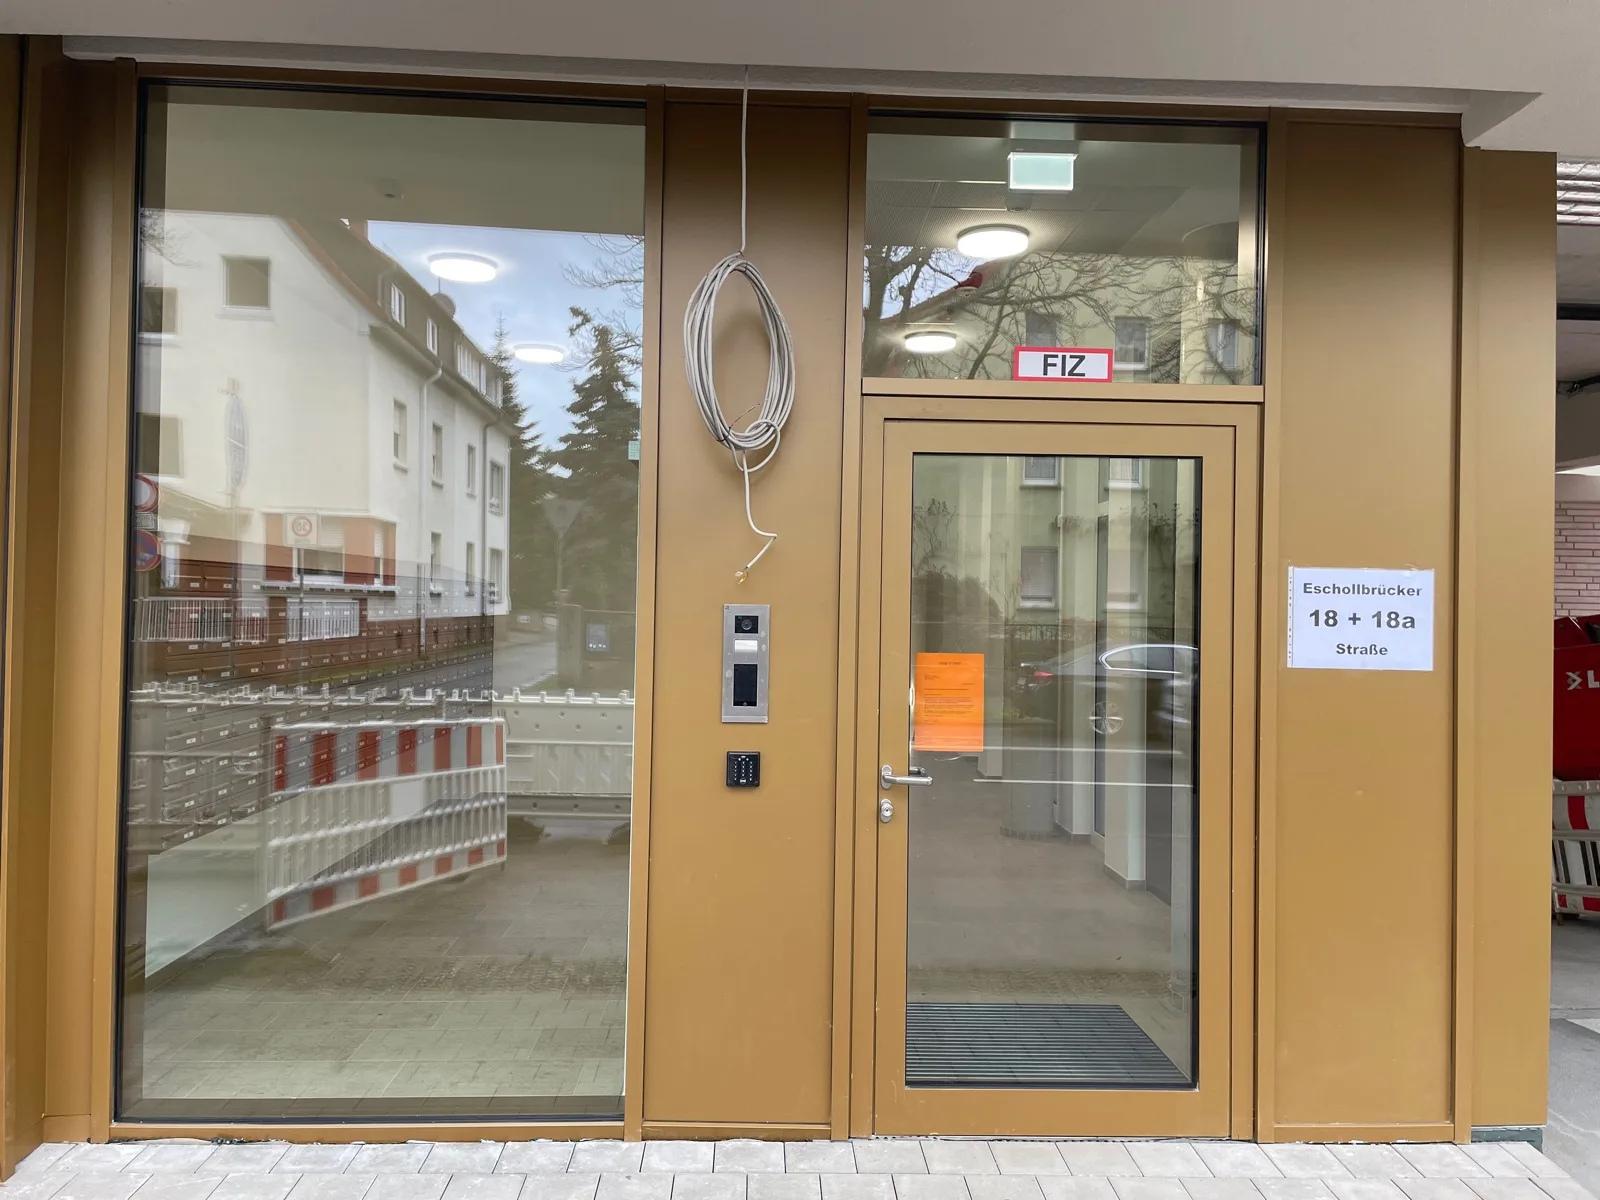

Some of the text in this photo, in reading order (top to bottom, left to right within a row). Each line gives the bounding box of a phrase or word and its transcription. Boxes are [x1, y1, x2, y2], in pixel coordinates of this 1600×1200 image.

[1042, 353, 1086, 377] FIZ
[1303, 582, 1422, 596] Eschollbrücker
[1309, 609, 1416, 629] 18 + 18a
[1336, 643, 1388, 656] Straße
